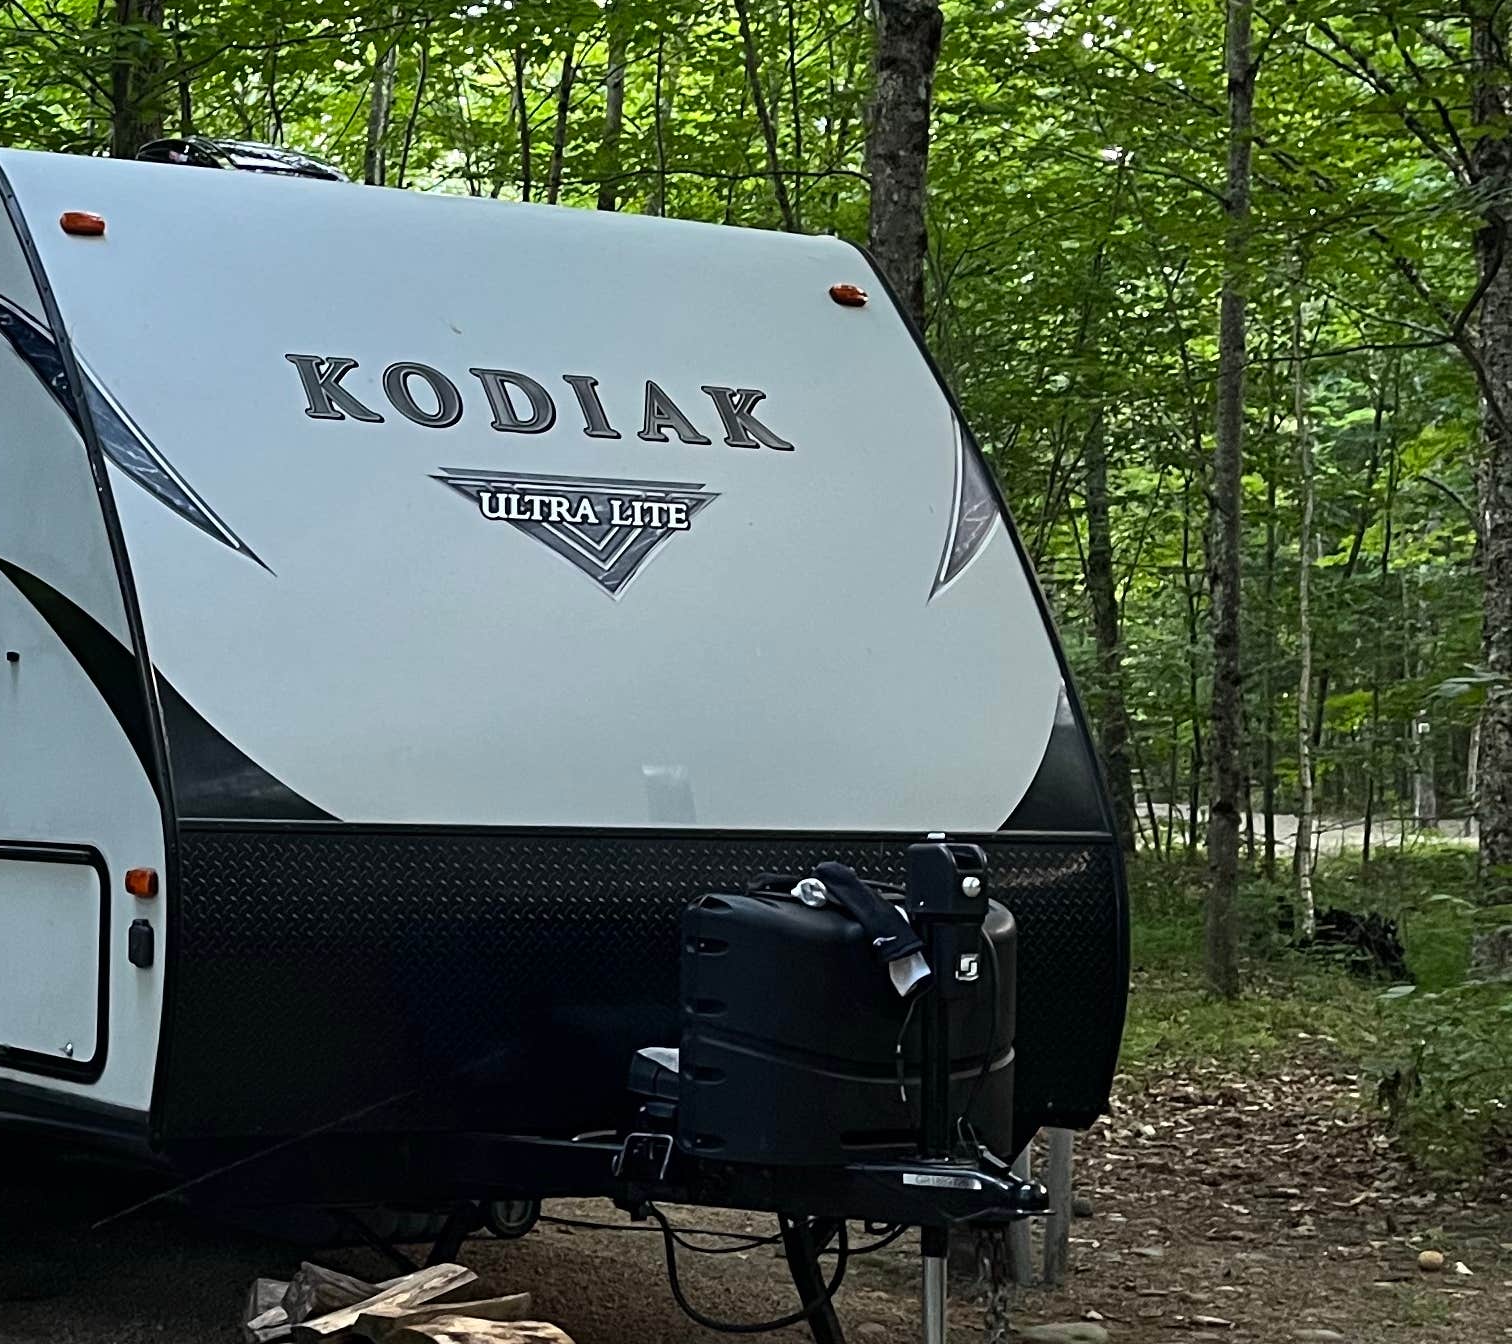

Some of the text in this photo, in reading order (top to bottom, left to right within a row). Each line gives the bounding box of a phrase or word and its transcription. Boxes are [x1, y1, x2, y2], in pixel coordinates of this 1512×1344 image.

[285, 353, 795, 452] KODIAK
[479, 491, 690, 530] ULTRA LITE
